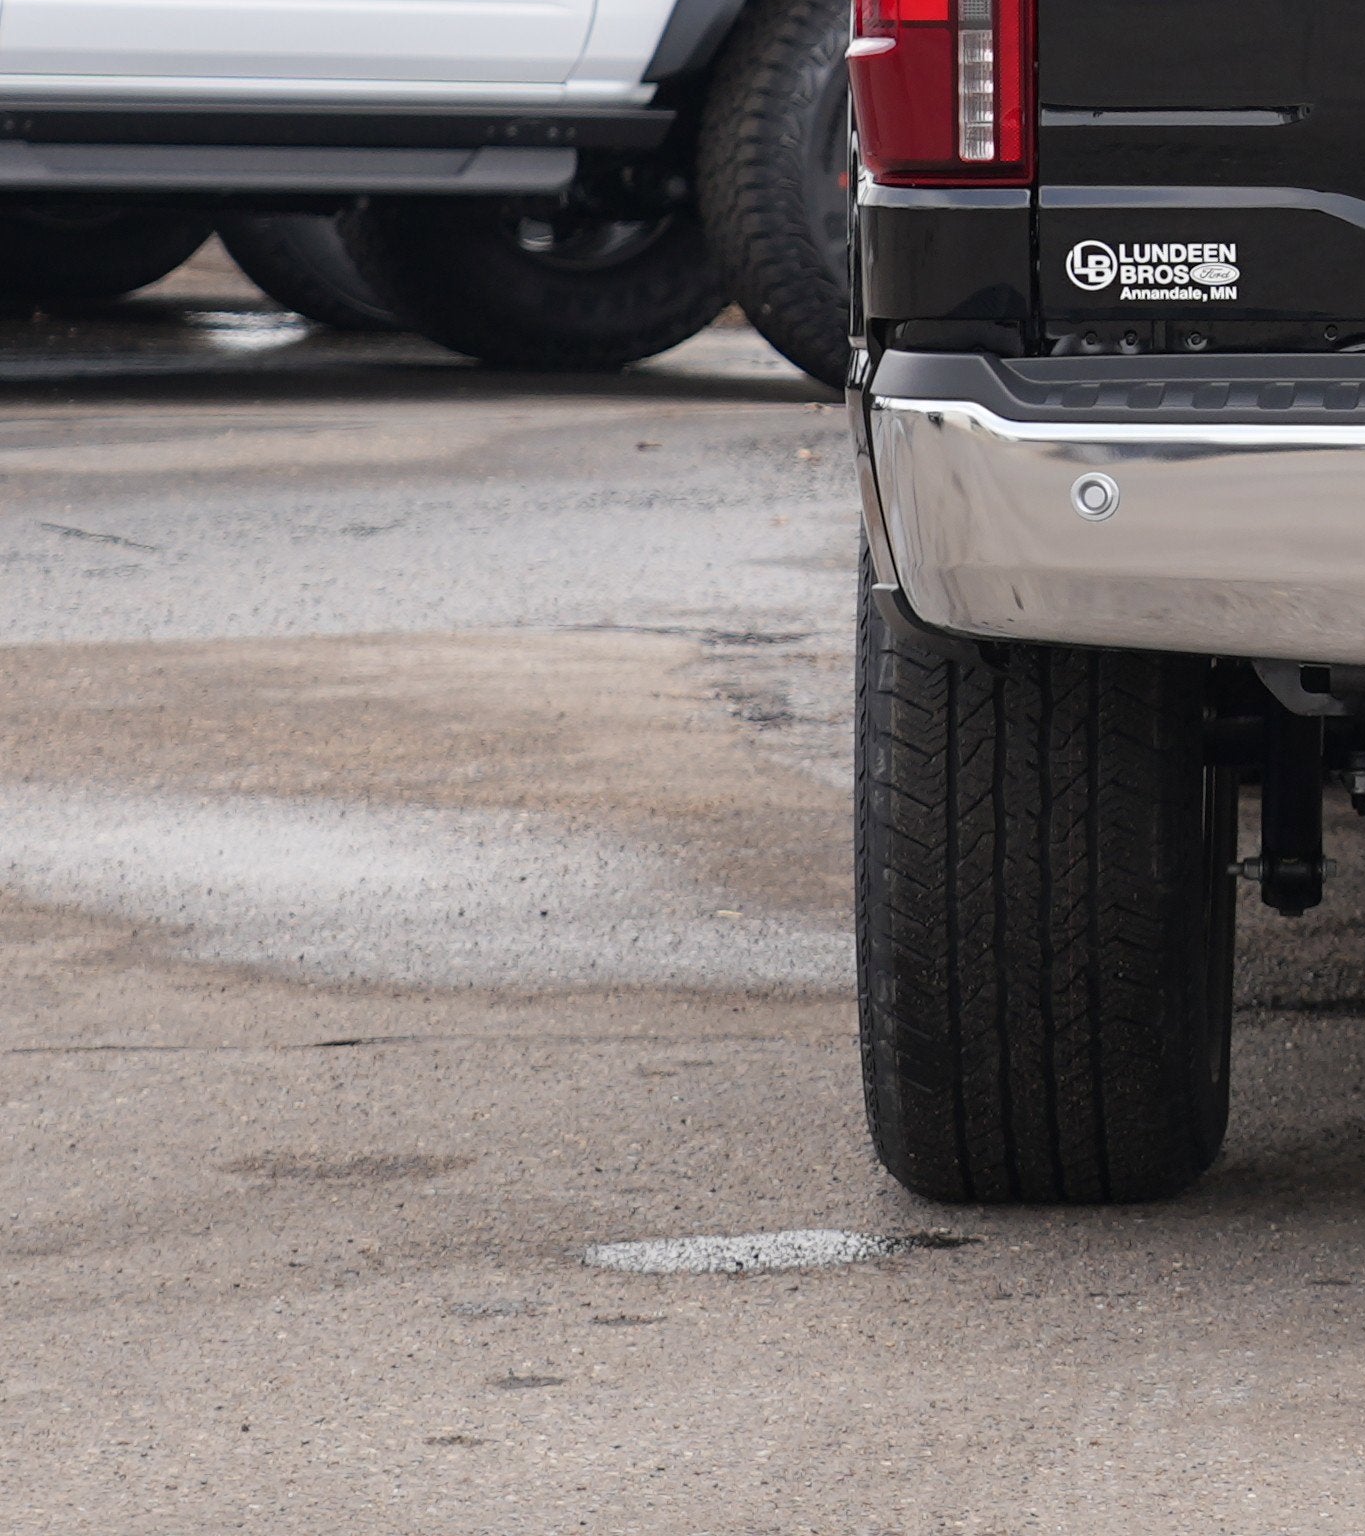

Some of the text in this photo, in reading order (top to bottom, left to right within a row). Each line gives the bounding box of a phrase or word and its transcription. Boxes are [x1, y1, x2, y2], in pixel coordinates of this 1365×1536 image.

[1119, 244, 1237, 263] LUNDEEN
[1120, 265, 1189, 285] BROS
[1120, 286, 1237, 302] Annandale, MN
